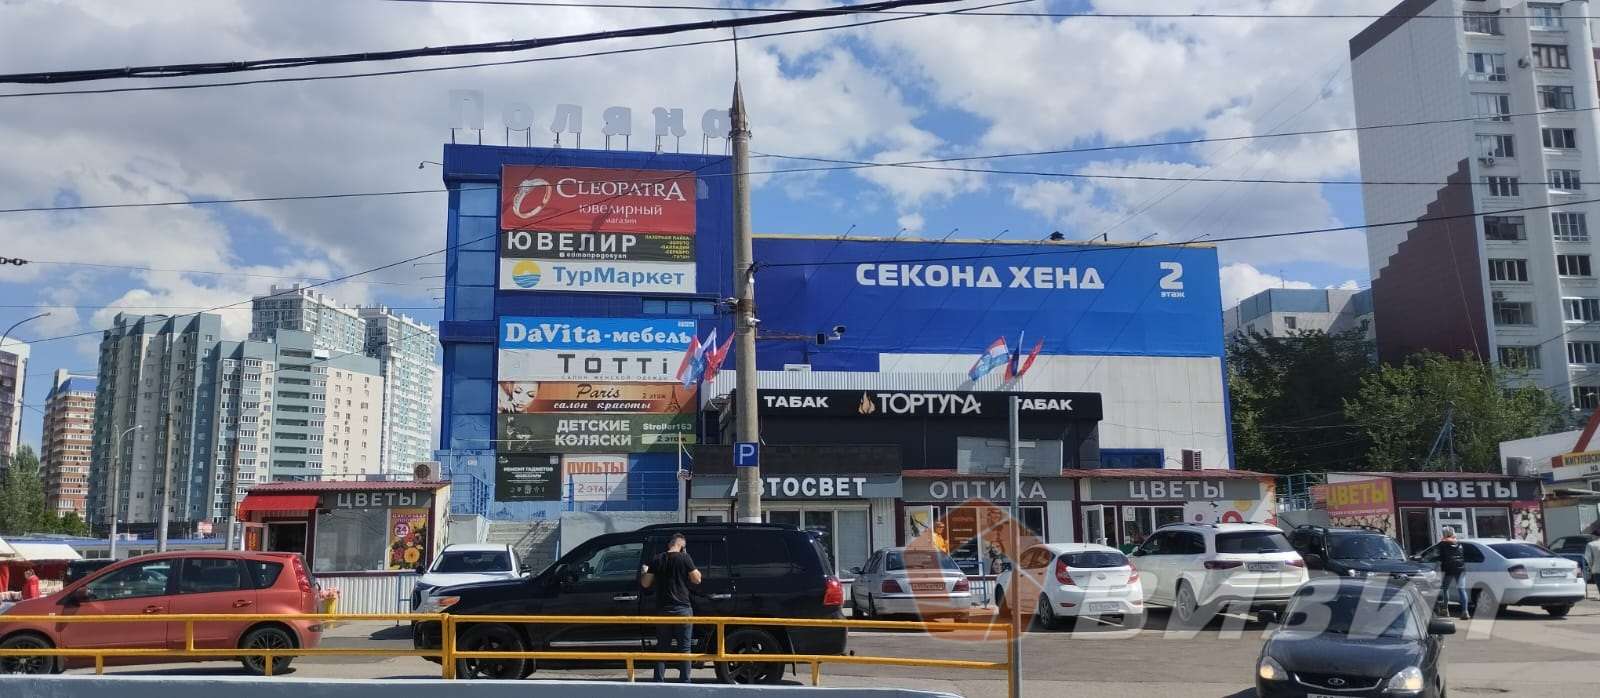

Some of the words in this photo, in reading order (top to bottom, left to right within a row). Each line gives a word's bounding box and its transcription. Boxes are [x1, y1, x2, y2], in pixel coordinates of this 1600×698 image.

[556, 178, 687, 201] CLEOPATRA
[579, 203, 663, 217] ювелирный
[507, 232, 637, 252] ЮВЕЛИР
[553, 266, 685, 286] ТурМаркет
[855, 263, 1002, 288] СЕКОНД
[1008, 266, 1105, 290] ХЕНД
[1159, 261, 1184, 290] 2
[576, 384, 620, 399] Paris
[597, 402, 651, 411] красоты
[763, 395, 829, 408] ТАБАК
[876, 393, 982, 414] ТОРТУГА
[557, 420, 630, 433] ДЕТСКИЕ
[642, 423, 692, 431] Stroller163
[555, 435, 632, 446] КОЛЯСКИ
[567, 462, 625, 474] ПУЛЬТЫ
[1129, 481, 1224, 500] ЦВЕТЫ
[1422, 481, 1518, 501] ЦВЕТЫ
[337, 493, 416, 507] ЦВЕТЫ
